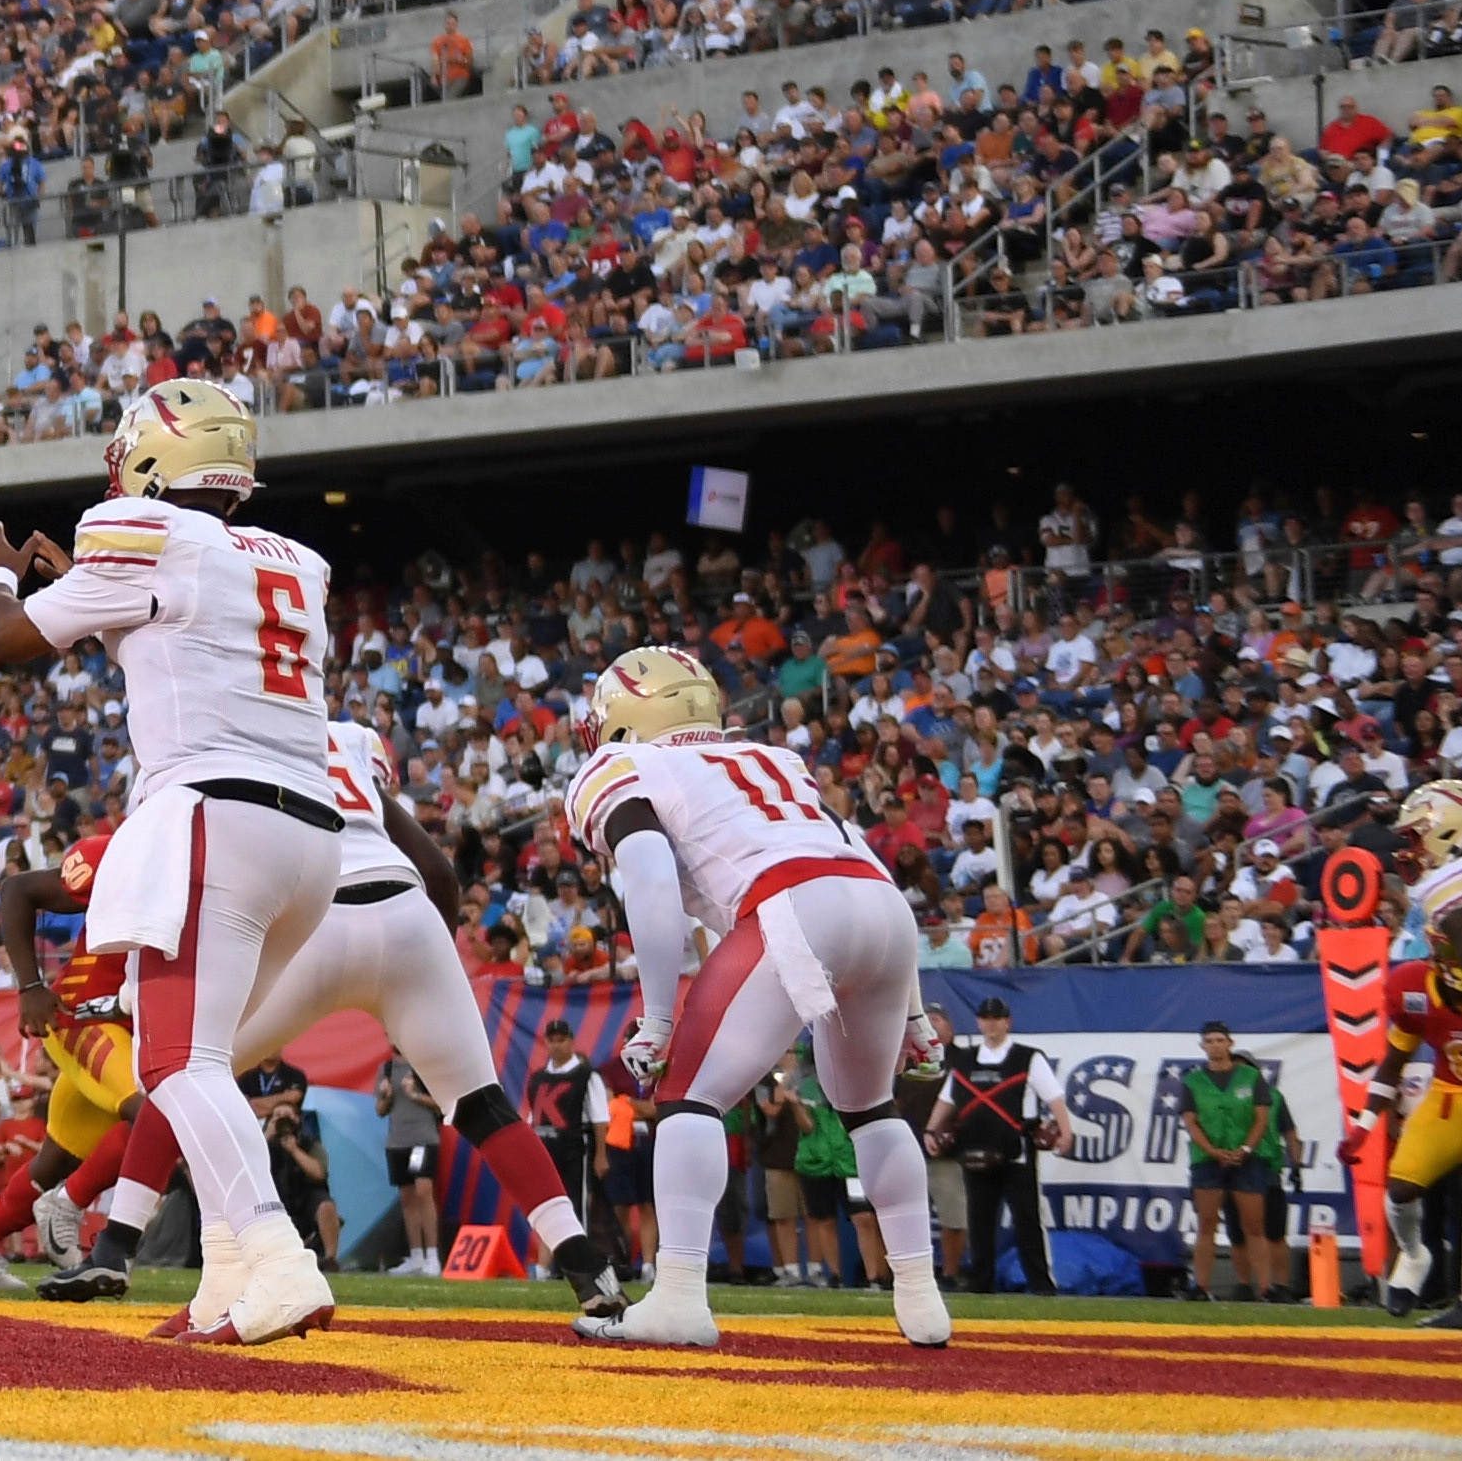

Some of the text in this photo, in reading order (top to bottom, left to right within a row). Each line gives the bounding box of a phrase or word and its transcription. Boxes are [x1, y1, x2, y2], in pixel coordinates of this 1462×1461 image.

[222, 521, 300, 566] SMITH
[251, 563, 313, 704] 6
[698, 748, 823, 822] 11
[533, 1081, 574, 1130] K
[448, 1233, 491, 1271] 20
